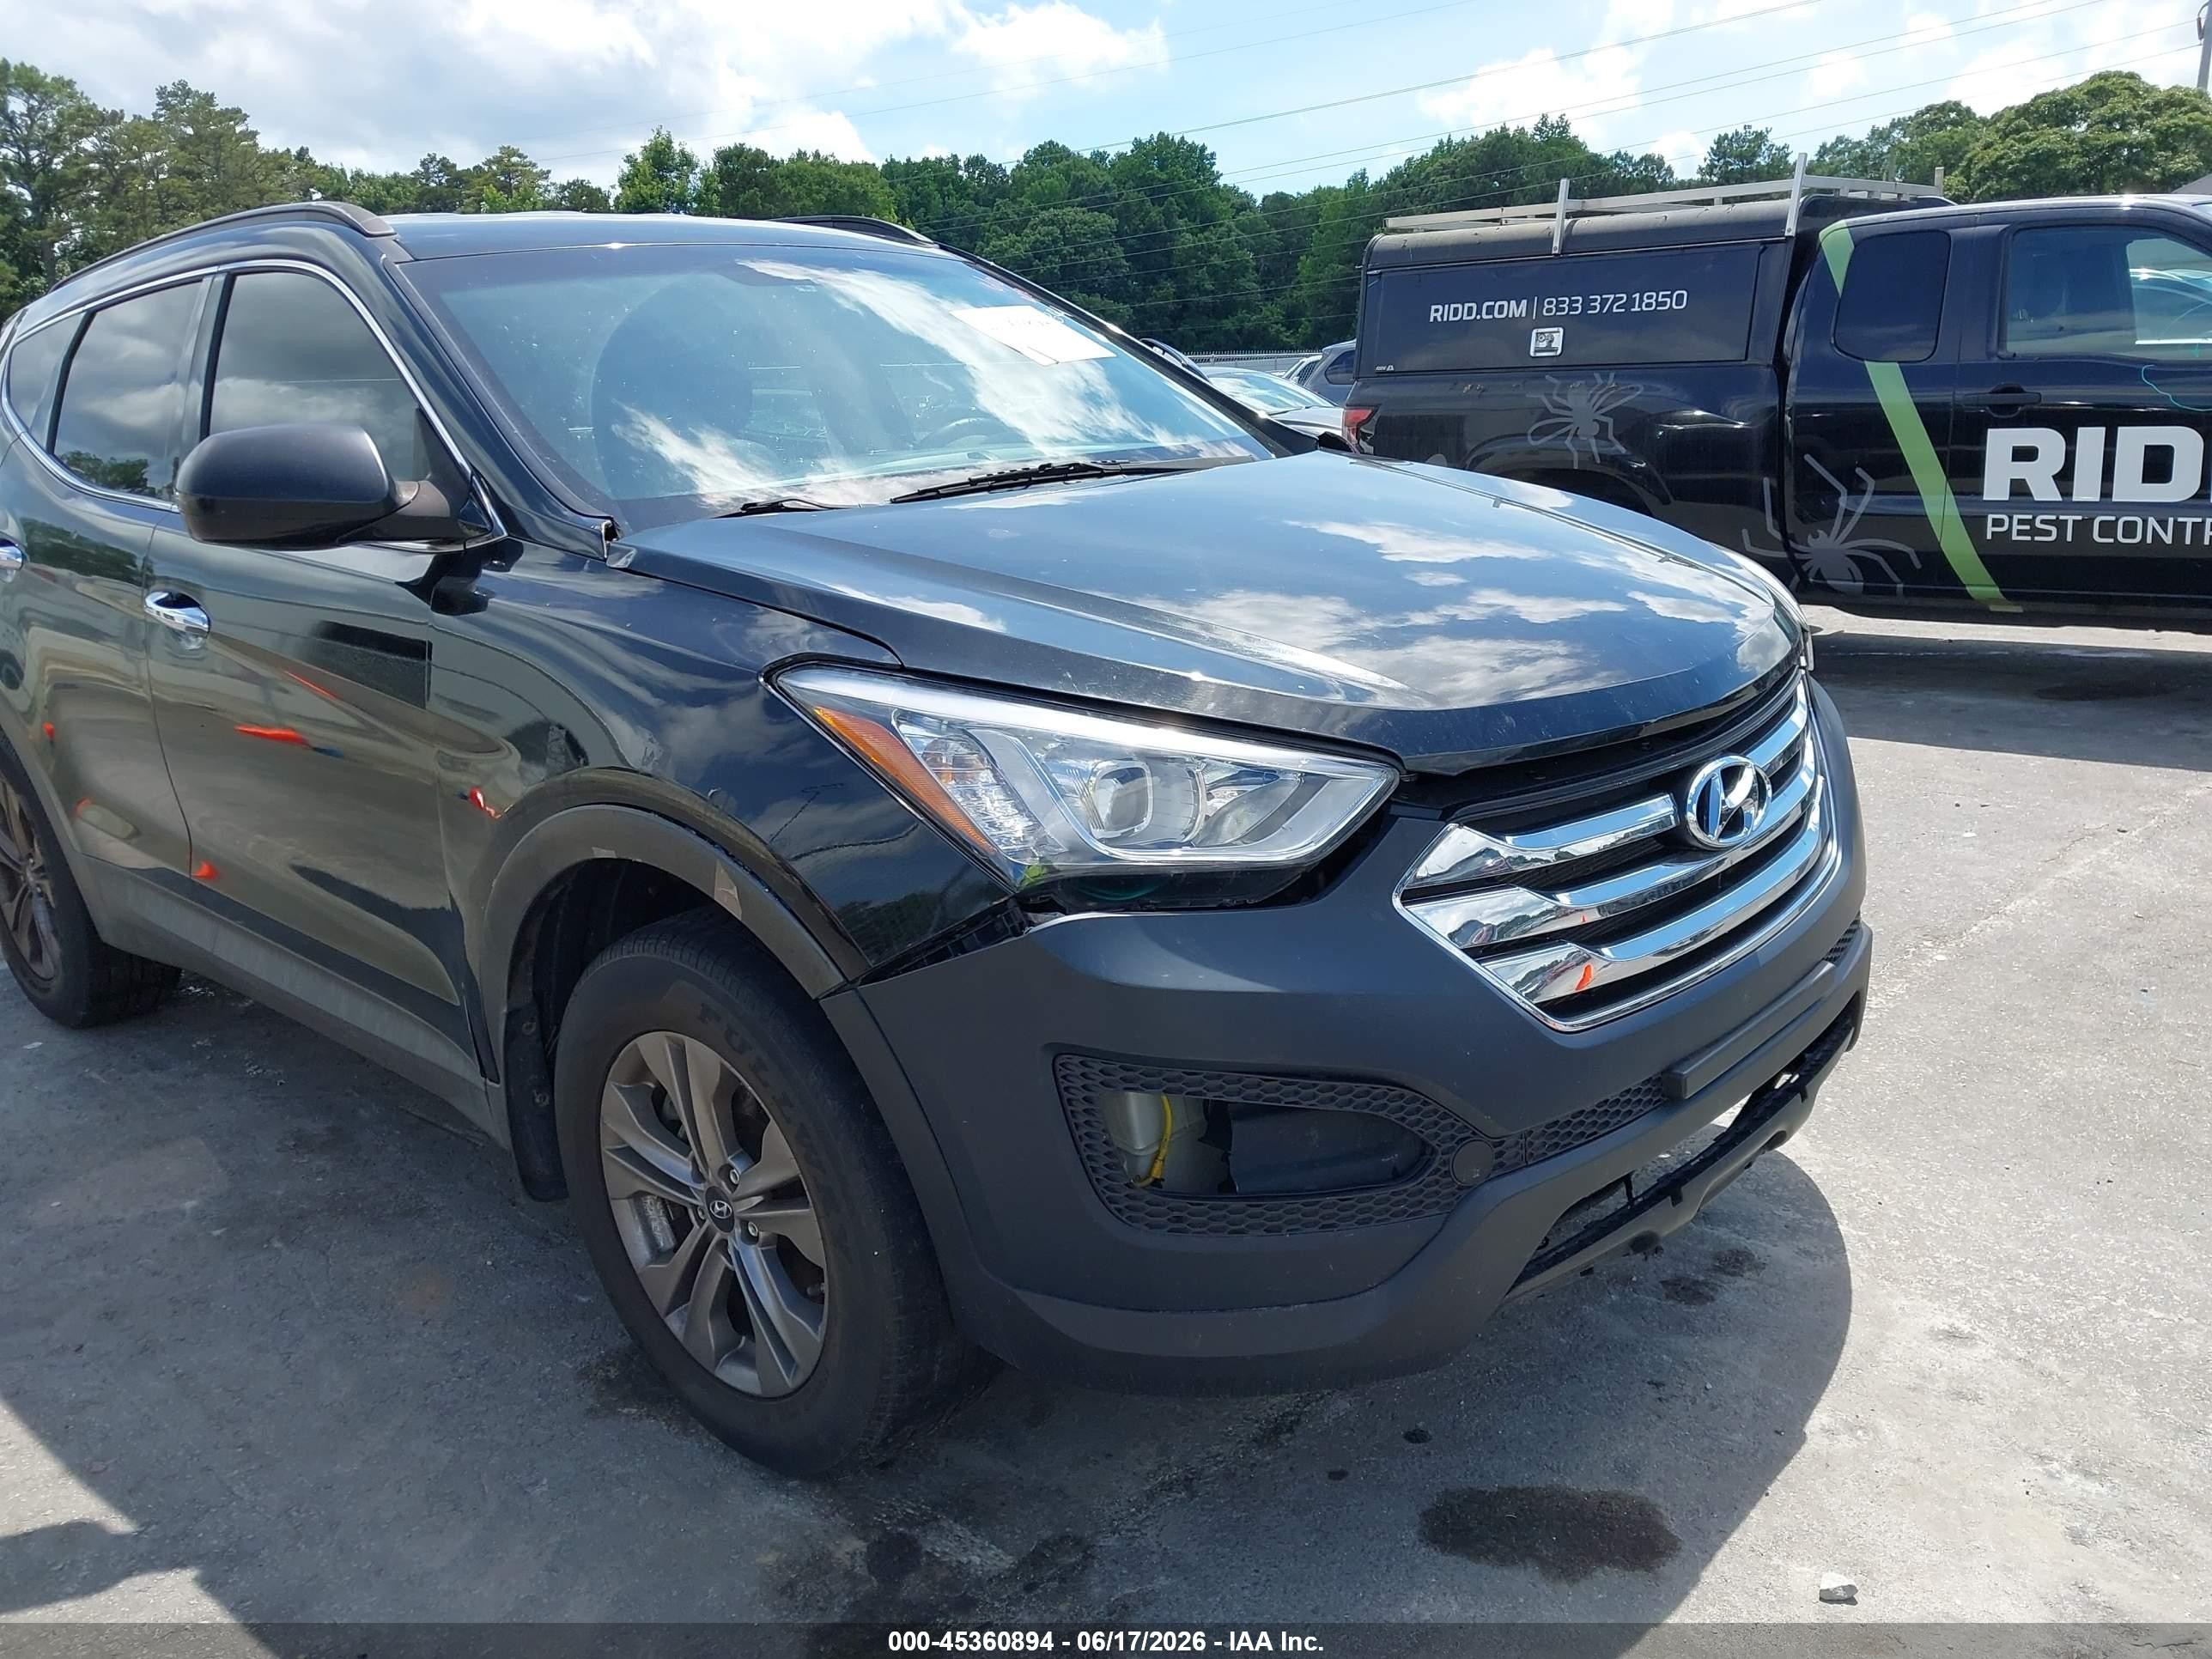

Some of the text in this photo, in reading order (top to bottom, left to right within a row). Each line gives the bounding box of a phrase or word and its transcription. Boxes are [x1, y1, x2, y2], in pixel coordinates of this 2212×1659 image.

[1429, 299, 1528, 323] RIDD.COM
[1542, 295, 1583, 316] 833
[1587, 294, 1627, 314] 372
[1630, 290, 1688, 312] 1850
[1982, 426, 2212, 502] RID
[1985, 514, 2084, 543] PEST
